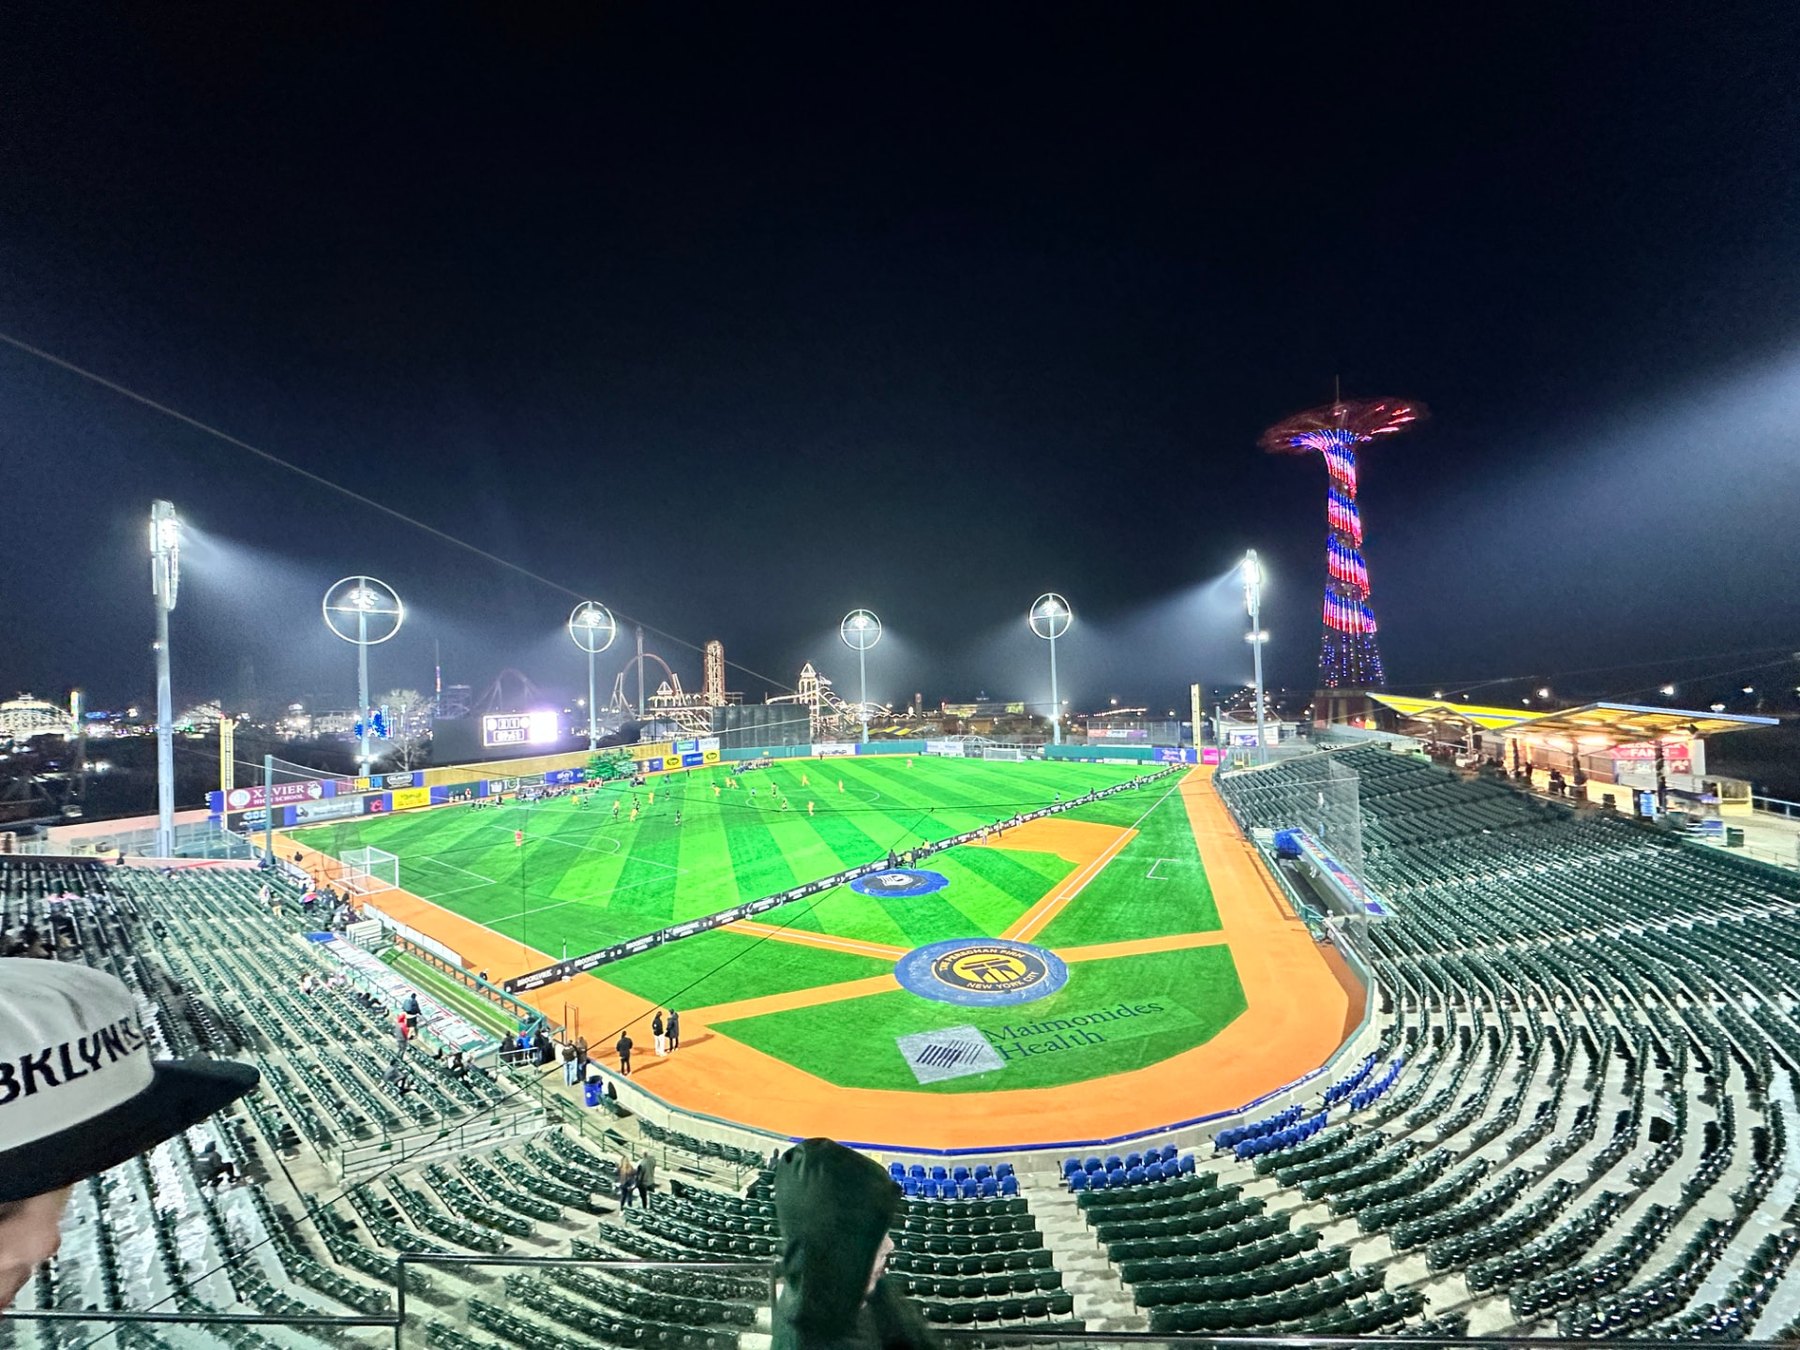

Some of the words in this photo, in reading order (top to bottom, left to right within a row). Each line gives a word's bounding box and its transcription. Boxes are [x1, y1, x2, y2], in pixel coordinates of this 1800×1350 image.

[274, 794, 305, 802] SCHOOL
[966, 981, 993, 990] NEW
[995, 981, 1025, 990] YORK
[1022, 971, 1040, 982] CITY
[981, 1001, 1165, 1043] Maimonides
[996, 1028, 1108, 1061] Health
